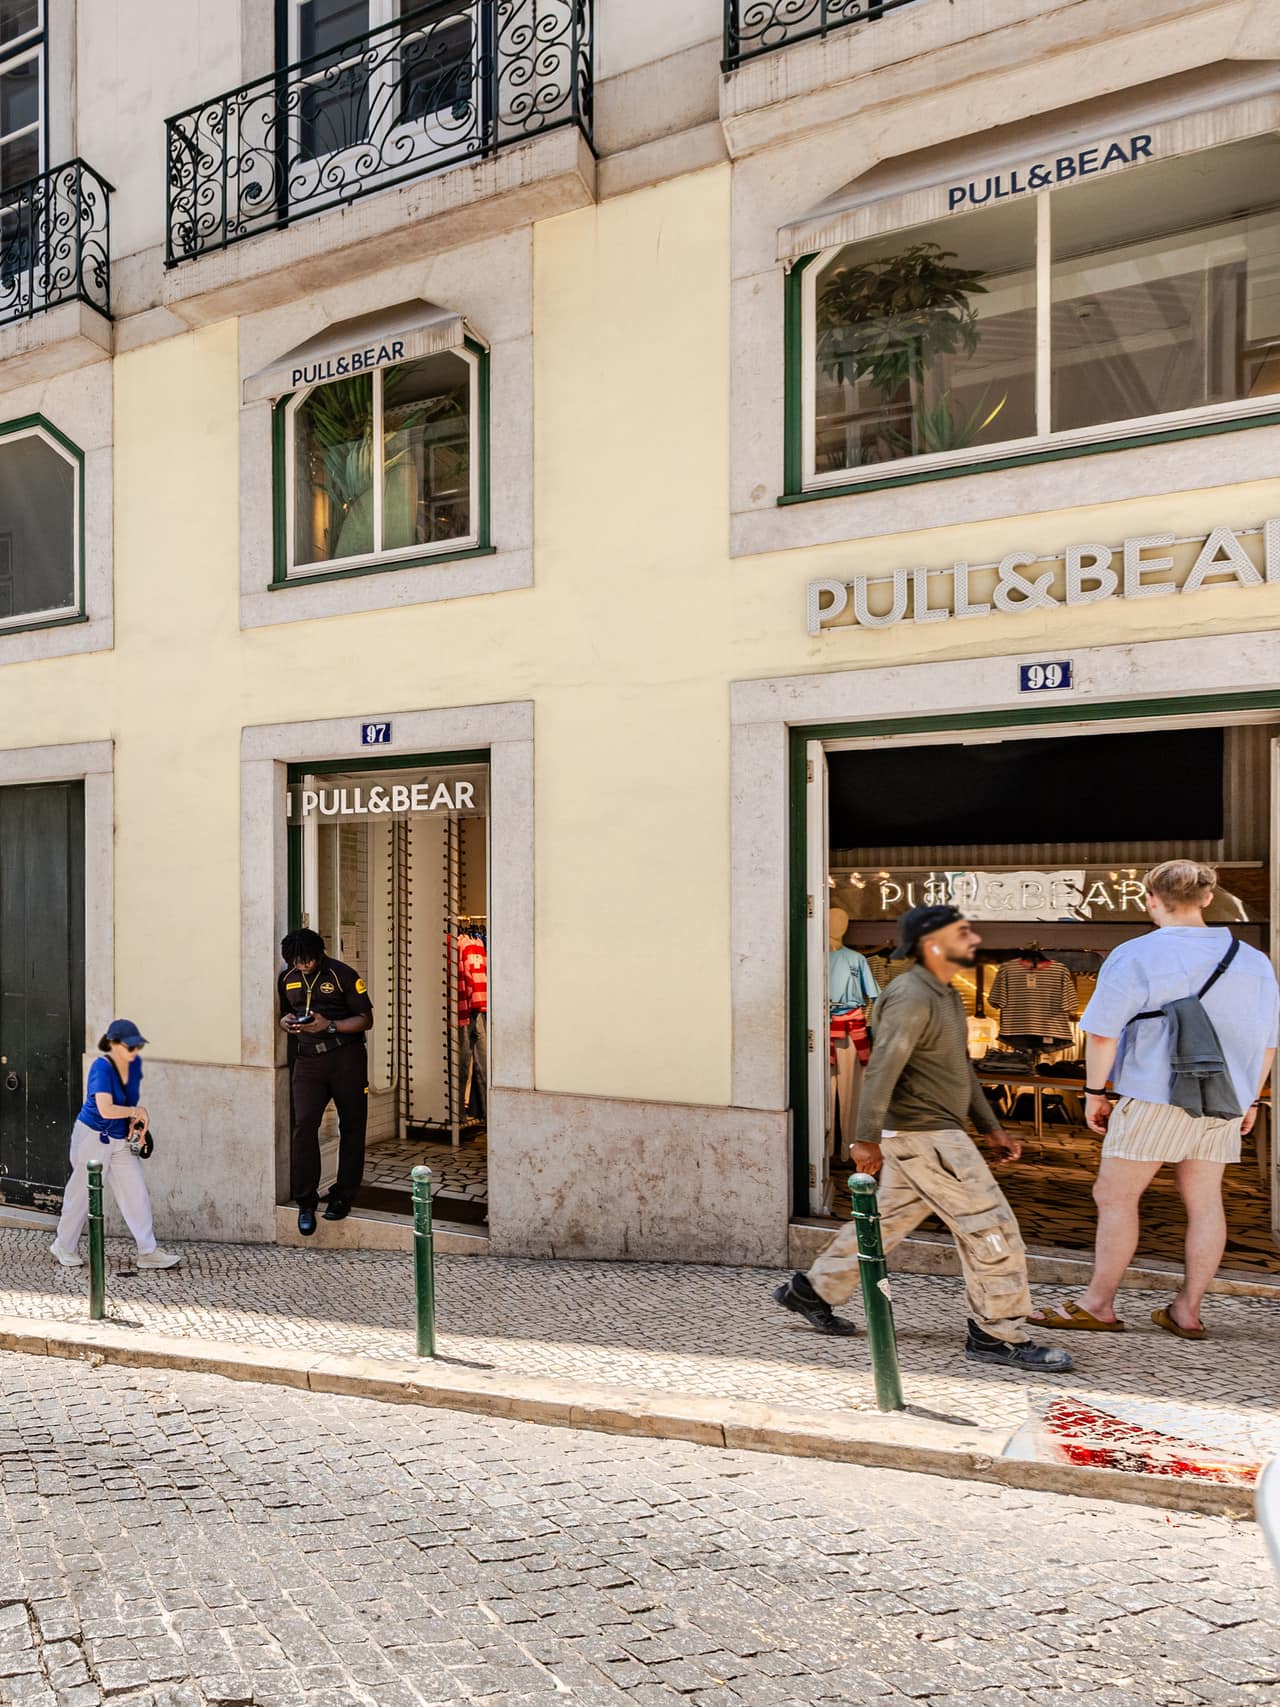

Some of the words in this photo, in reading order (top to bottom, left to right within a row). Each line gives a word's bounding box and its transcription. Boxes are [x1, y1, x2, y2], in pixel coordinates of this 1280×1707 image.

[949, 134, 1163, 210] PULL&BEAR
[292, 341, 404, 387] PULL&BEAR
[807, 519, 1280, 637] PULL&BEA
[1026, 663, 1063, 688] 99
[366, 724, 386, 743] 97
[302, 781, 475, 817] PULL&BEAR
